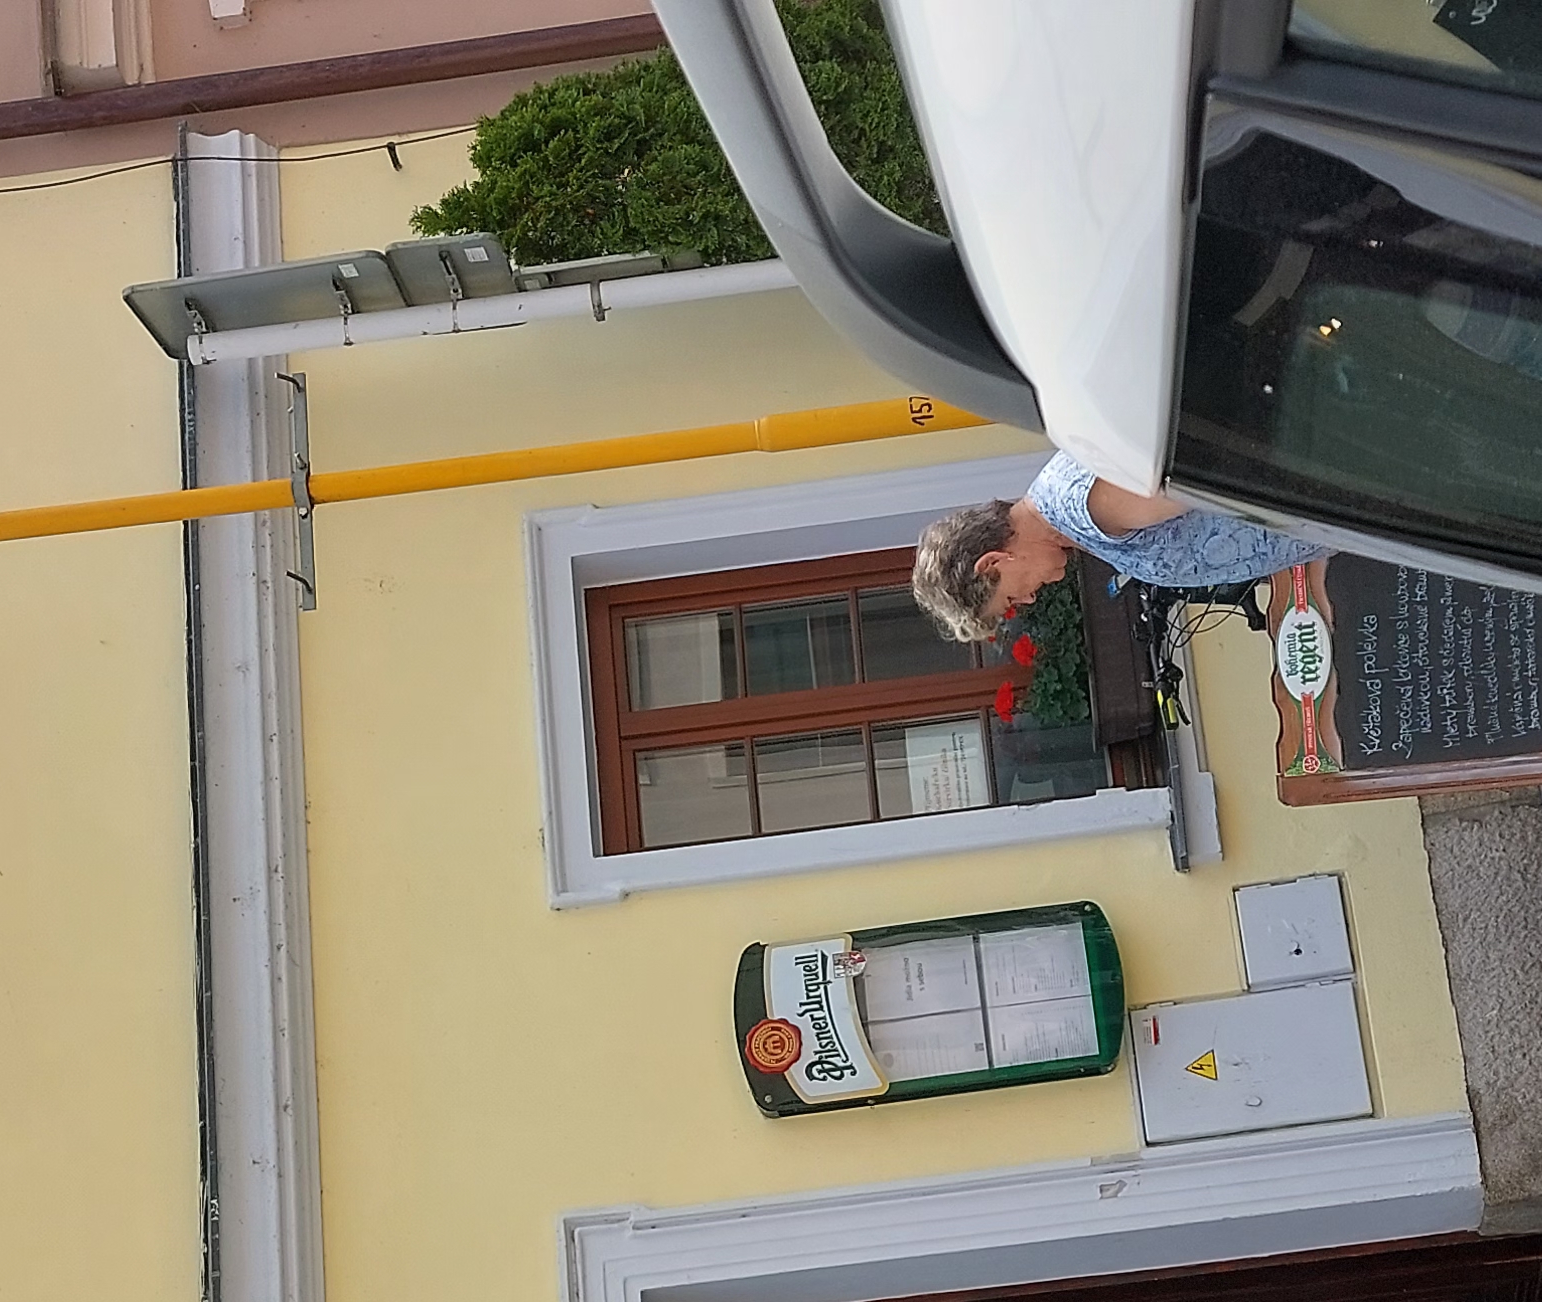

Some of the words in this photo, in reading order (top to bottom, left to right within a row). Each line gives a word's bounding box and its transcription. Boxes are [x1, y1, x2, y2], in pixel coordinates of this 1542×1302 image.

[1358, 613, 1390, 674] polévka
[1395, 620, 1409, 629] s
[794, 953, 833, 1017] Urquell
[804, 1013, 858, 1082] Pilsner
